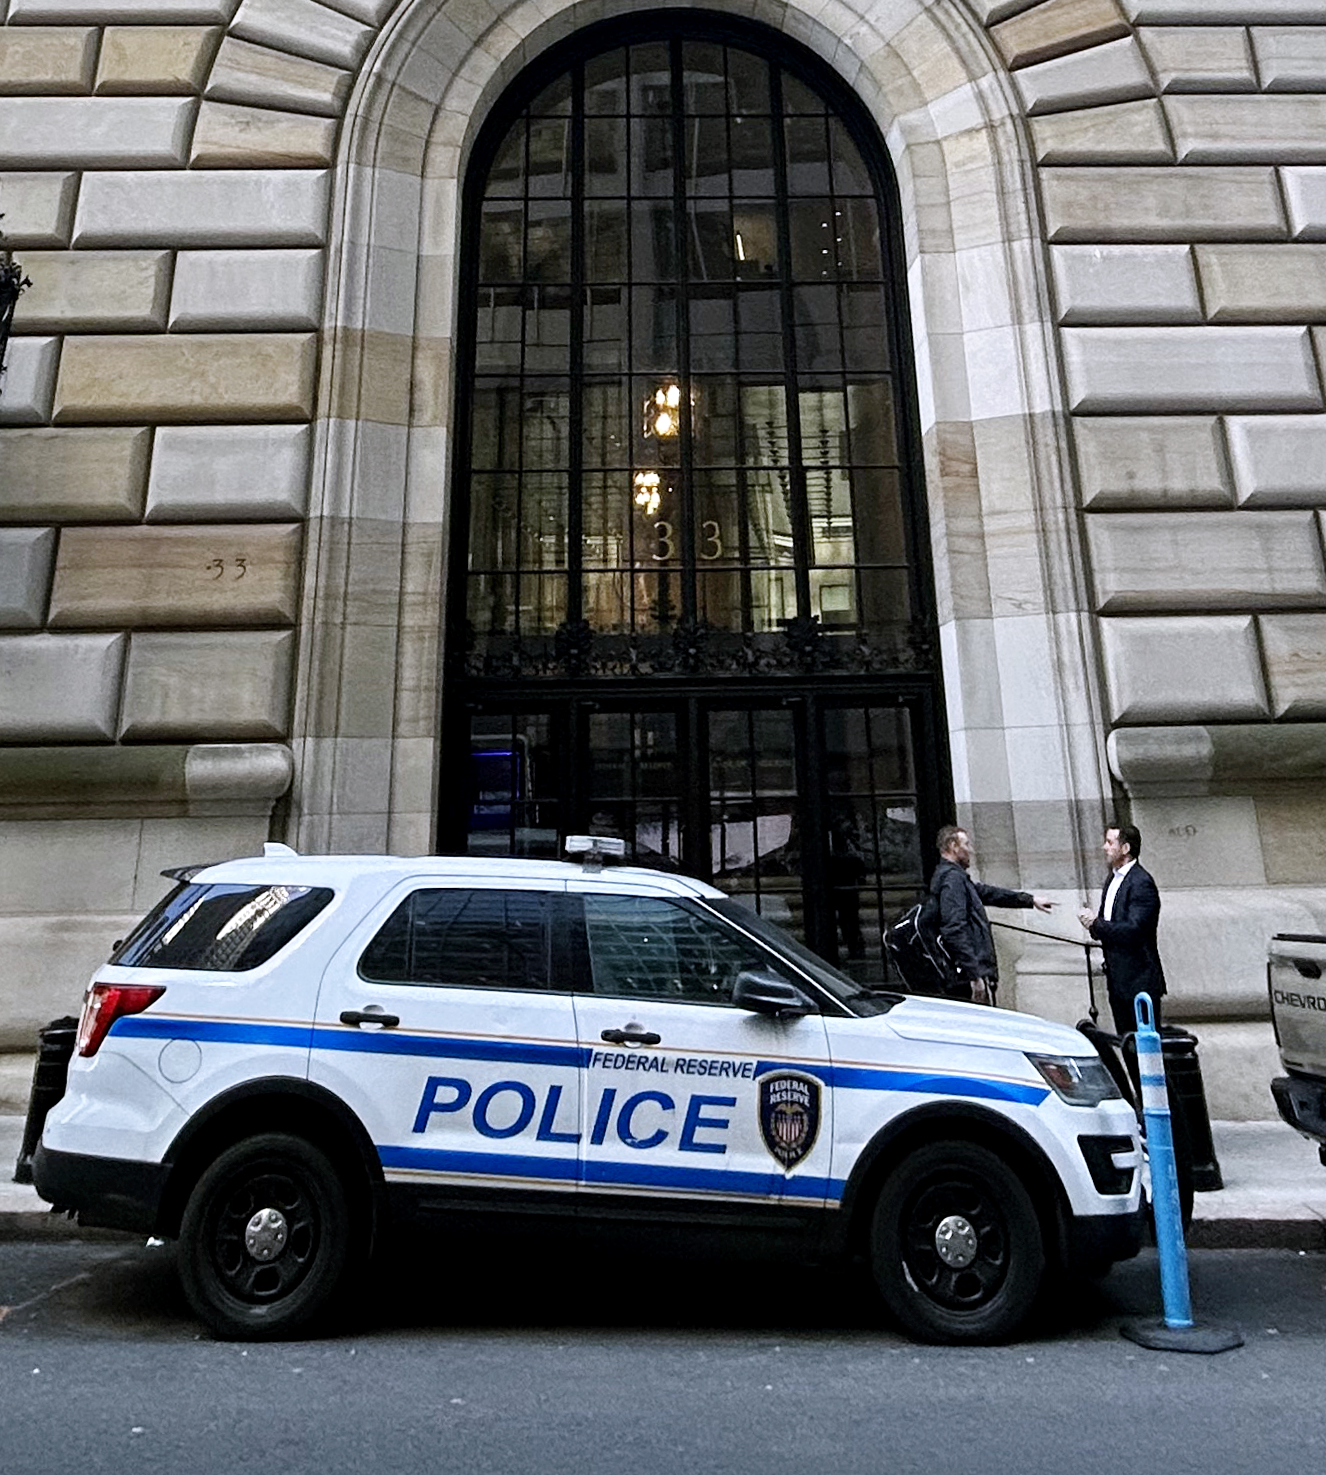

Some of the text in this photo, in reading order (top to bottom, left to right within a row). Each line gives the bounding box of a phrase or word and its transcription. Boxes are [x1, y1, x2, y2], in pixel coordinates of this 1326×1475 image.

[592, 1052, 753, 1078] FEDERAL RESERVE
[769, 1079, 810, 1096] FEDERAL
[769, 1091, 811, 1107] RESERVE
[412, 1076, 737, 1154] POLICE
